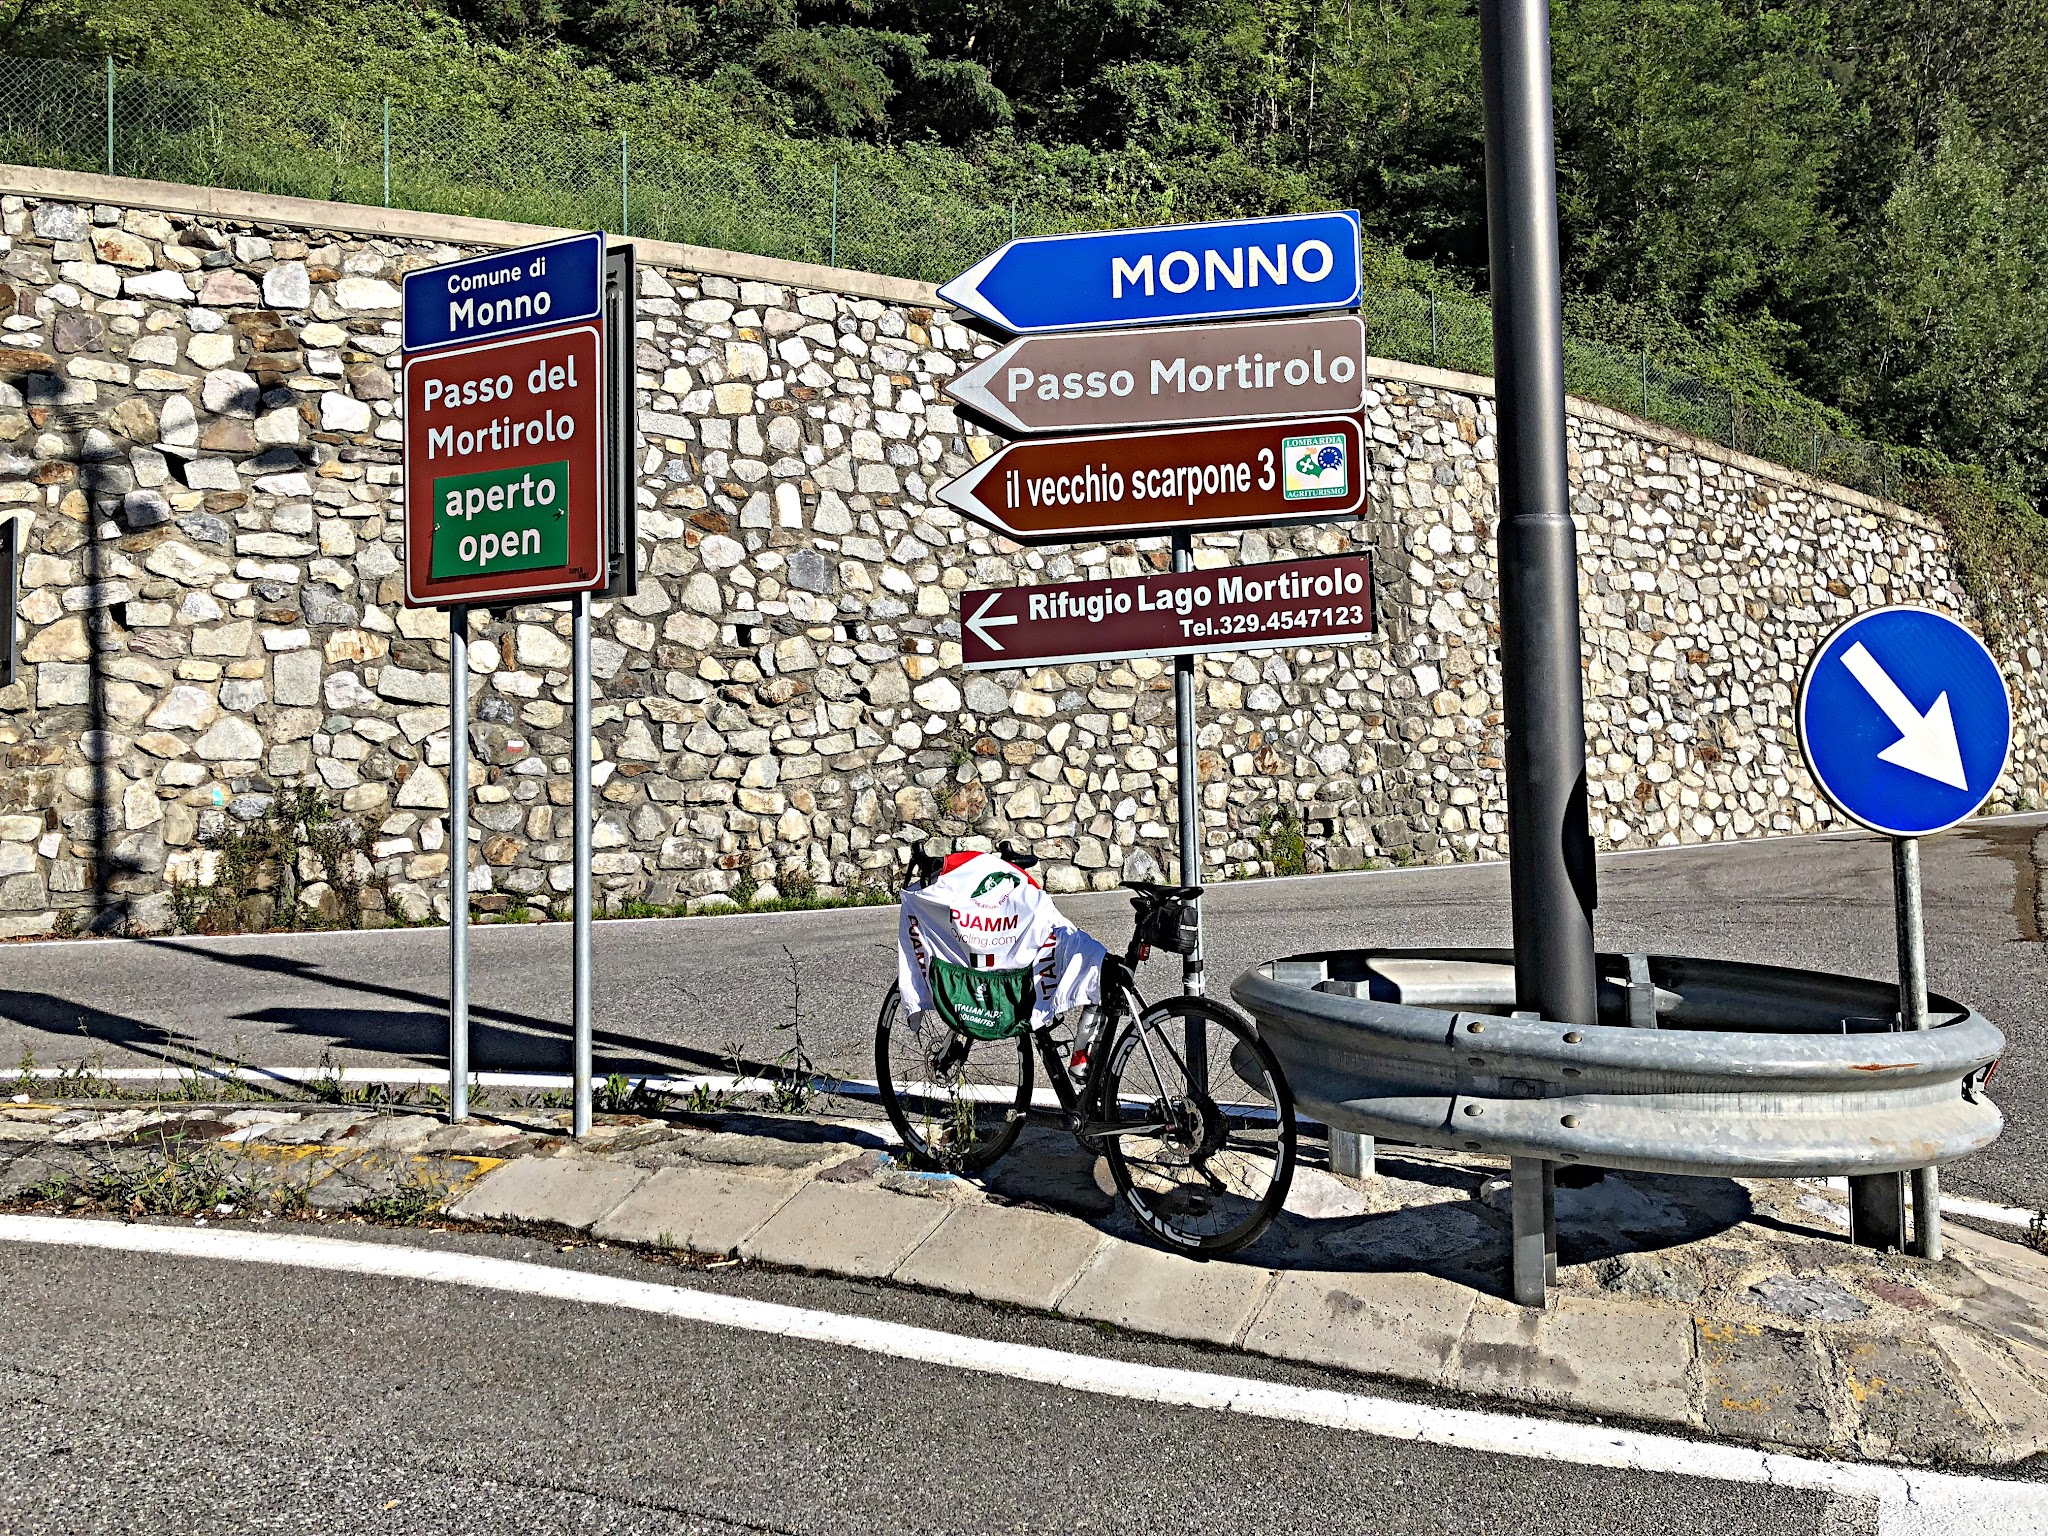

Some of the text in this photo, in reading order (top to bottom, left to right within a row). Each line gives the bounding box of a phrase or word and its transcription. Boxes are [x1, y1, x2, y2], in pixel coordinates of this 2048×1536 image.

[447, 256, 546, 294] Comune di
[1112, 239, 1334, 299] MONNO
[449, 291, 552, 332] Monno
[424, 354, 578, 412] Passo del
[1008, 349, 1356, 403] Passo Mortirolo
[428, 409, 575, 460] Mortirolo
[1286, 436, 1343, 447] LOMBARDIA
[445, 473, 556, 521] aperto
[1006, 448, 1276, 509] il vecchio scarpone 3
[1287, 487, 1345, 498] AGRITURISMO
[458, 528, 541, 567] open
[1029, 567, 1364, 623] Rifugio Lago Mortirolo
[1179, 605, 1364, 638] Tel.329.4547123
[950, 908, 1019, 932] PJAMM
[954, 1003, 984, 1016] ITALIAN
